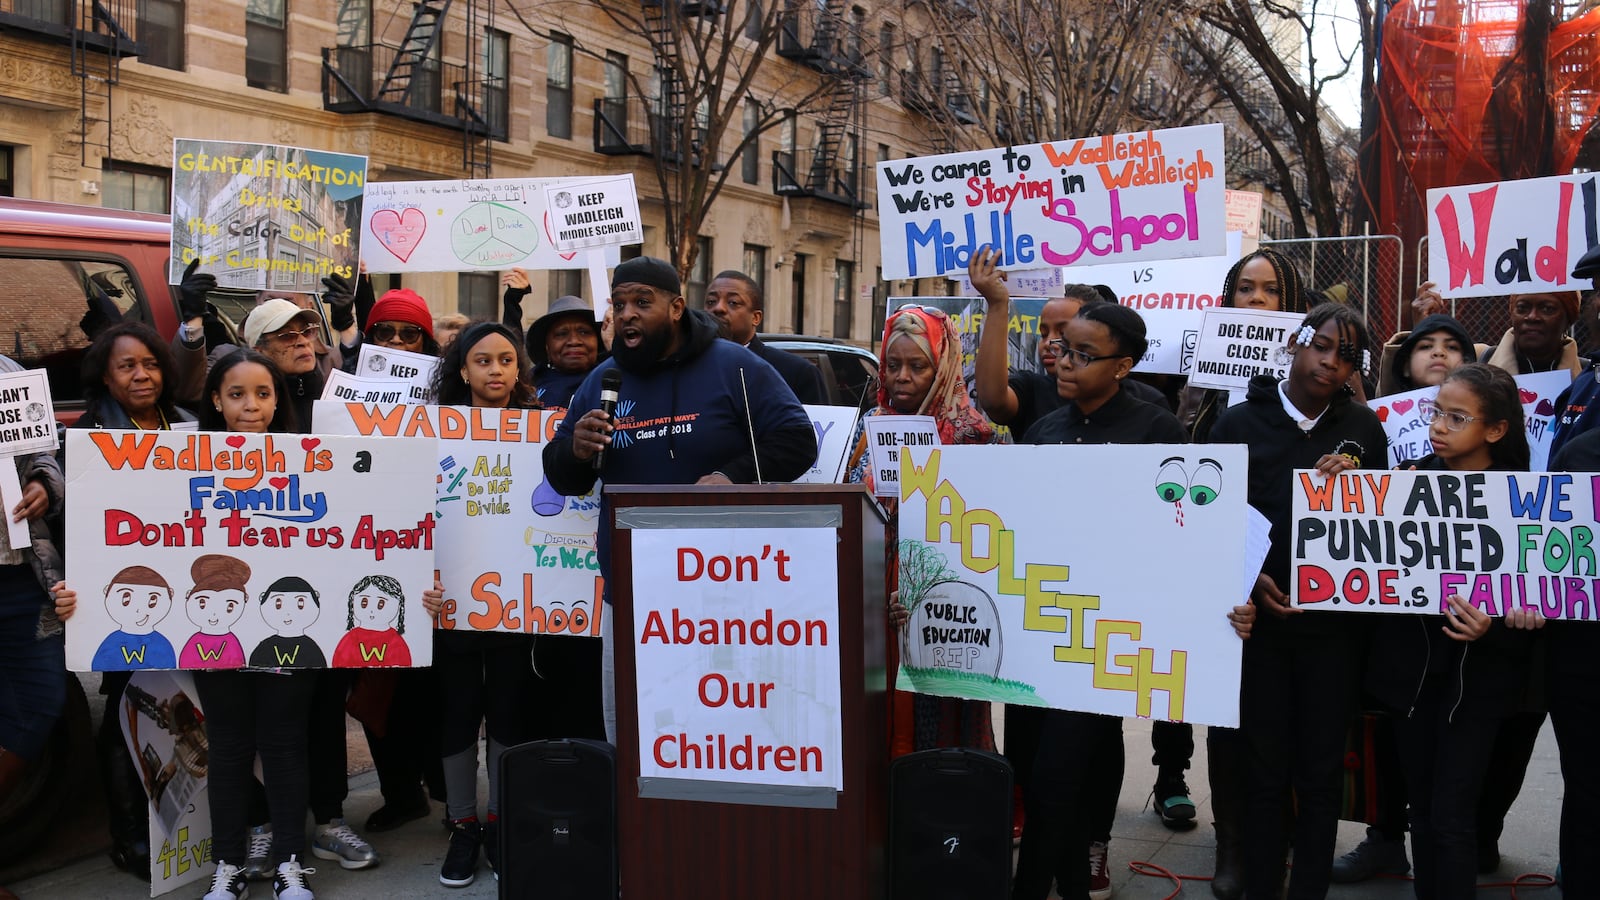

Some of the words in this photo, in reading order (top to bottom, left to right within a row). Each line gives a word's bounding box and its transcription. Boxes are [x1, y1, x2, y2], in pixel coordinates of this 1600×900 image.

[179, 153, 363, 187] GENTRIFICATION
[884, 164, 925, 187] We
[931, 158, 991, 180] came
[1002, 147, 1031, 173] to
[1041, 130, 1162, 172] Wadleigh
[892, 190, 955, 214] We're
[965, 173, 1053, 217] Staying
[1062, 169, 1085, 194] in
[1096, 149, 1214, 193] Wadleigh
[239, 189, 303, 212] Drives
[577, 192, 605, 207] KEEP
[564, 206, 624, 226] WADLEIGH
[186, 217, 219, 236] the
[228, 220, 281, 239] Color
[289, 224, 327, 244] Out
[331, 228, 352, 247] of
[559, 226, 593, 241] MIDDLE
[595, 221, 634, 236] SCHOOL!
[905, 210, 1035, 277] Middle
[1041, 185, 1199, 266] School
[226, 250, 352, 279] Communities
[1133, 267, 1154, 284] VS
[1217, 323, 1243, 339] DOE
[1246, 325, 1286, 343] CAN'T
[1226, 343, 1269, 362] CLOSE
[390, 364, 418, 378] KEEP
[1198, 361, 1260, 379] WADLEIGH
[380, 391, 402, 403] NOT
[636, 430, 656, 440] Class
[658, 426, 668, 437] of
[672, 423, 692, 434] 2018
[918, 432, 934, 446] NOT
[89, 433, 286, 490] Wadleigh
[301, 438, 333, 472] is
[352, 450, 372, 473] a
[1393, 441, 1418, 463] WE
[472, 453, 512, 477] Add
[189, 474, 327, 523] Family
[467, 481, 484, 496] Do
[488, 480, 512, 494] Not
[1299, 472, 1391, 516] WHY
[1403, 473, 1488, 519] ARE
[1507, 474, 1573, 522] WE
[467, 495, 511, 516] Divide
[105, 508, 207, 547] Don't
[220, 509, 299, 547] tear
[307, 526, 344, 549] us
[351, 512, 436, 561] Apart
[533, 545, 557, 568] Yes
[559, 546, 584, 569] We
[1296, 517, 1504, 572] PUNISHED
[1517, 524, 1596, 577] FOR
[677, 545, 791, 582] Don't
[468, 571, 604, 637] School
[924, 602, 977, 624] PUBLIC
[641, 608, 828, 646] Abandon
[922, 626, 991, 648] EDUCATION
[933, 646, 980, 669] RIP
[698, 673, 775, 709] Our
[653, 733, 823, 772] Children
